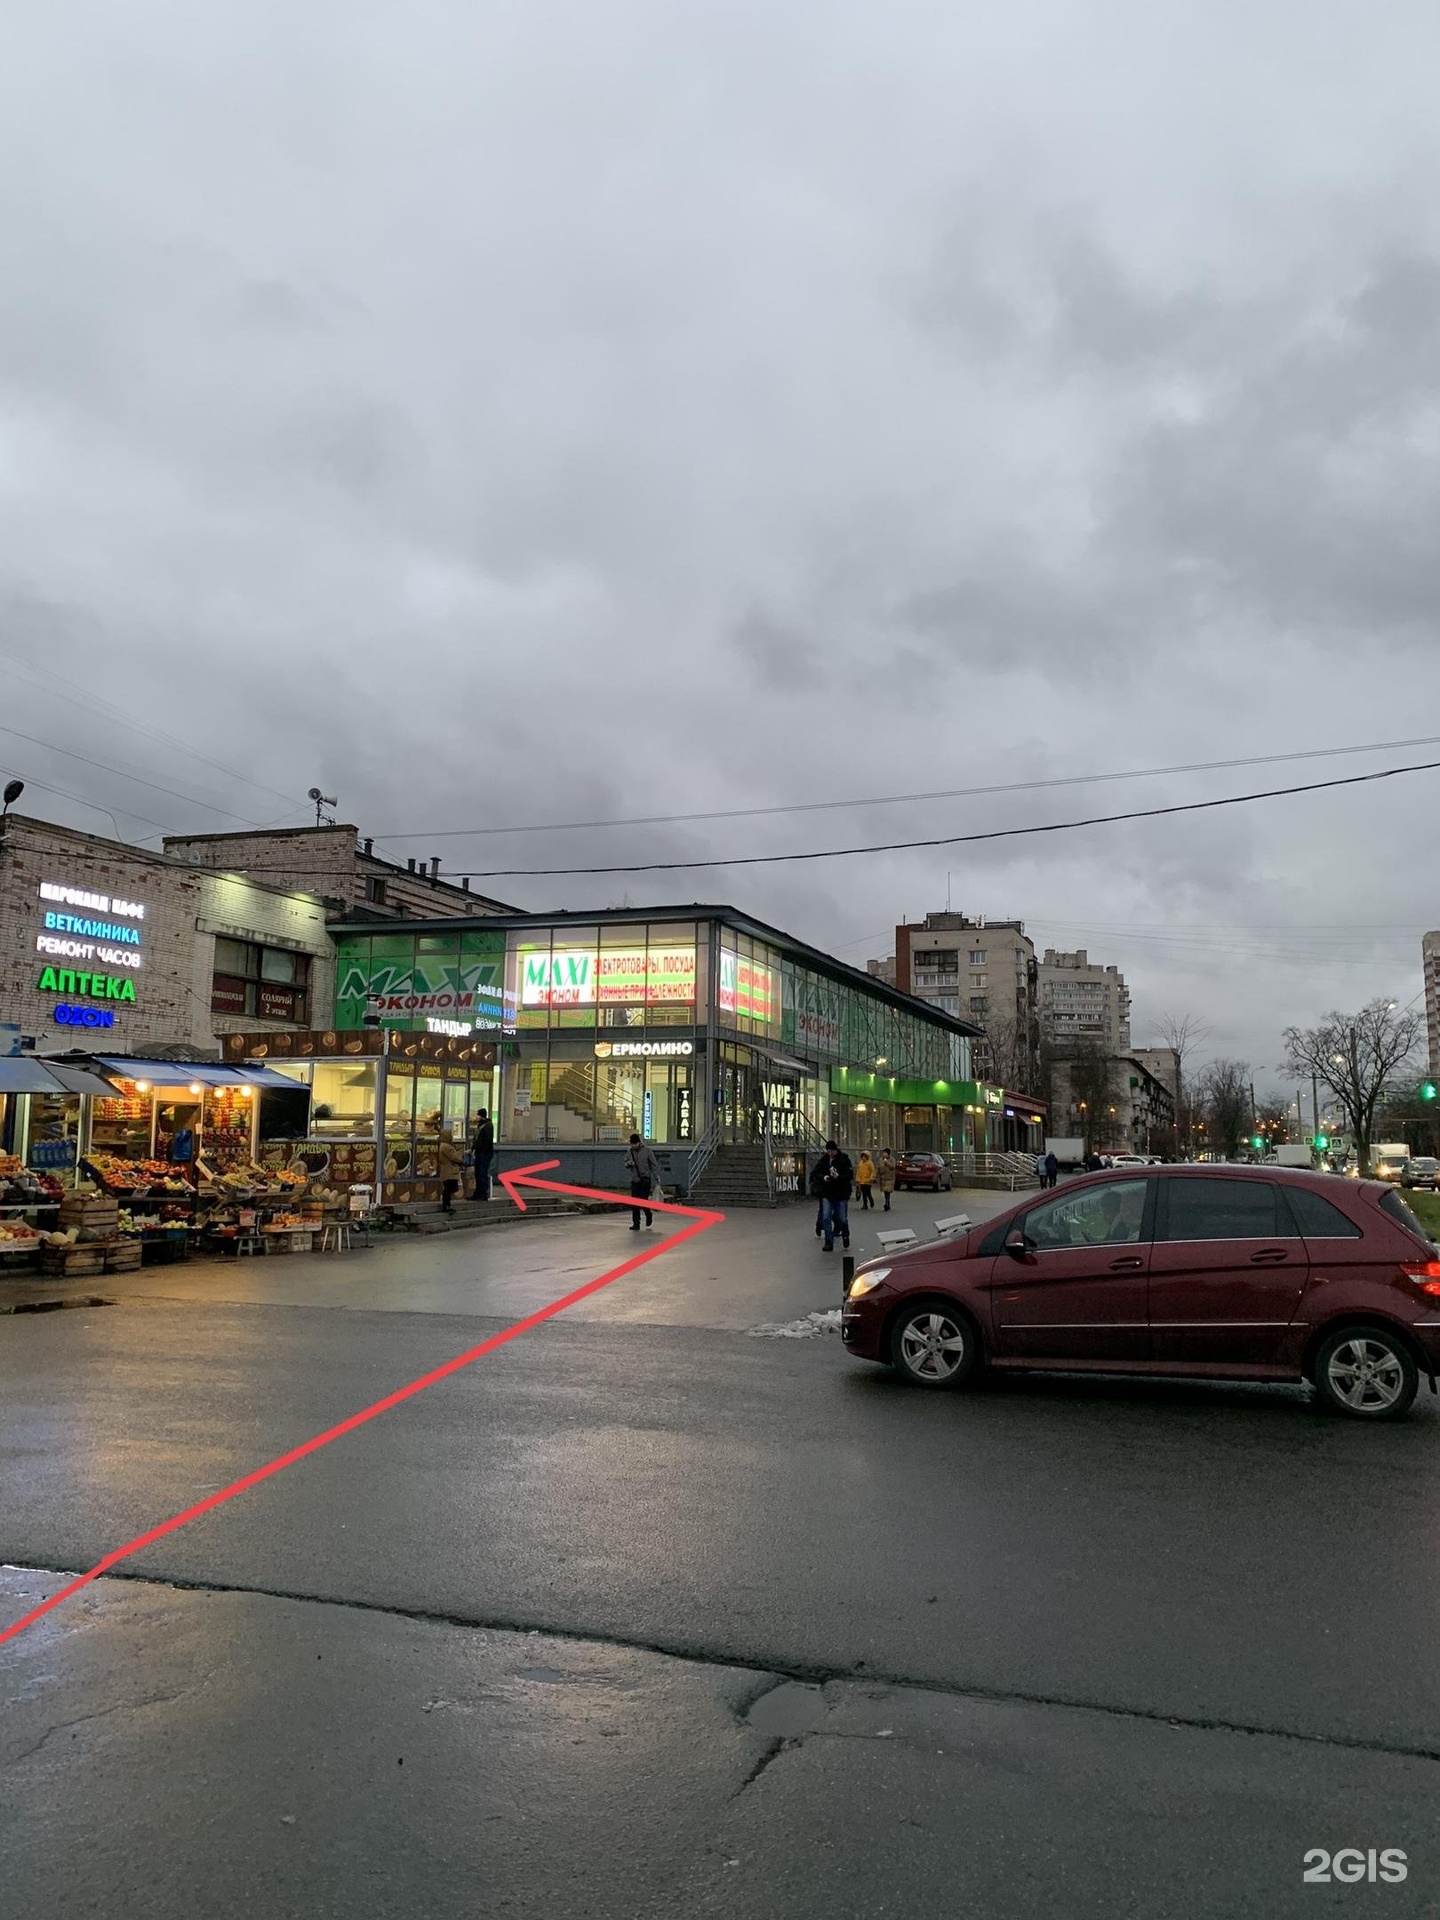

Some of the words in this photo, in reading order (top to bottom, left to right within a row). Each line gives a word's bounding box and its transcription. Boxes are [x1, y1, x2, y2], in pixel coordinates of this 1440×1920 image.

[45, 912, 140, 945] ВЕТКЛИНИКА
[37, 935, 95, 960] РЕМОНТ
[96, 946, 141, 968] ЧАСОВ
[664, 956, 694, 974] ПОСУДА
[39, 966, 136, 1003] АПТЕКА
[338, 963, 500, 999] MAXI
[265, 1004, 270, 1013] 2
[376, 993, 473, 1010] ЭКОНОМ
[538, 989, 580, 1003] ЭКОНОМ
[54, 1002, 115, 1029] OZON
[426, 1017, 472, 1037] ТАНДЫР
[612, 1042, 692, 1055] ЕРМОЛИНО
[762, 1082, 791, 1109] VAPE
[681, 1090, 690, 1137] ТАБАК
